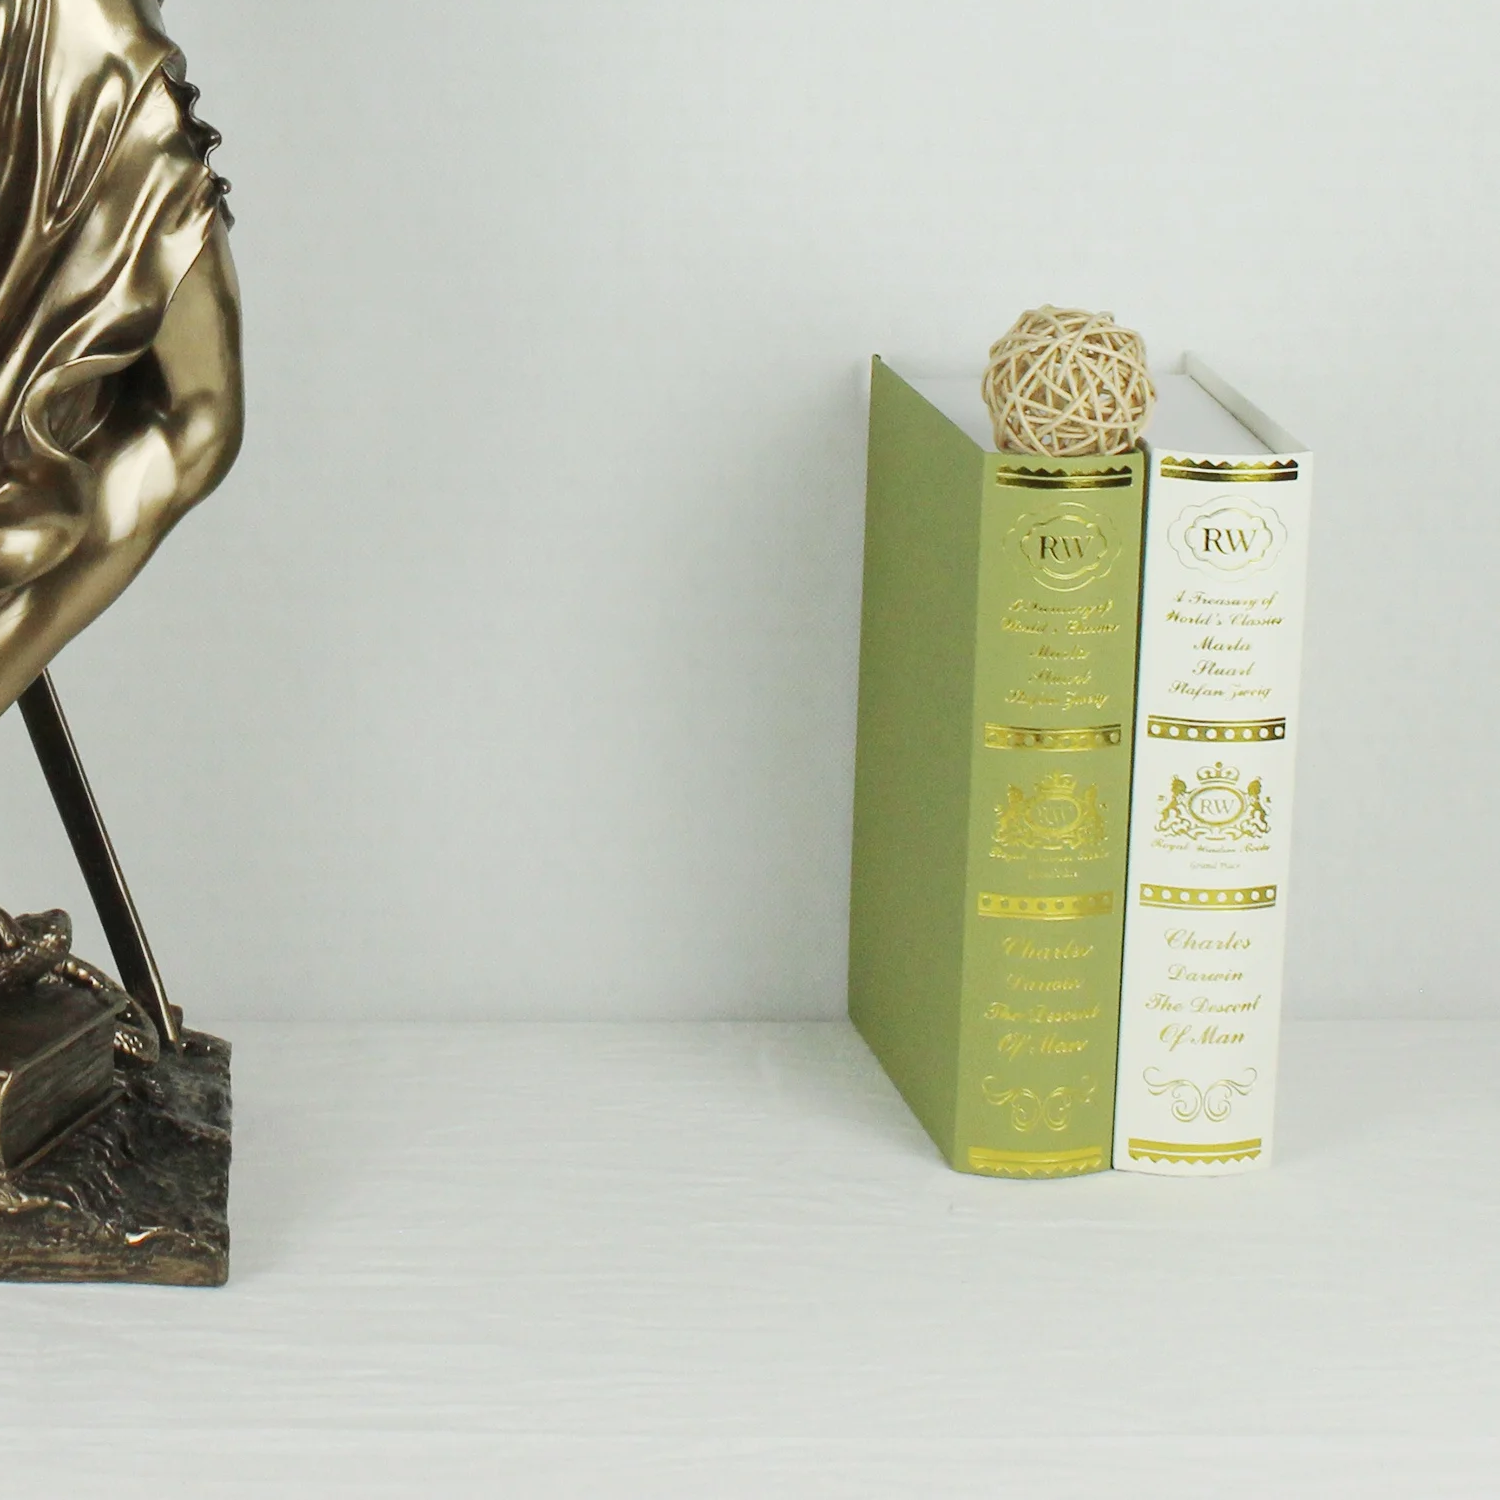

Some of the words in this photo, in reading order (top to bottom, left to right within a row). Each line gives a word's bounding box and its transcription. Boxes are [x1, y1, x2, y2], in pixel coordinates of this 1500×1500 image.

[1040, 536, 1094, 564] RW
[1202, 528, 1257, 554] RW
[1188, 591, 1256, 610] Treasury
[1261, 591, 1278, 610] of
[1200, 799, 1234, 815] RW
[1164, 928, 1250, 949] Charles
[1168, 963, 1243, 981] Darwin
[1145, 993, 1182, 1011] The
[1190, 995, 1261, 1013] Descent
[1160, 1023, 1192, 1052] Of
[1190, 1024, 1244, 1045] Man
